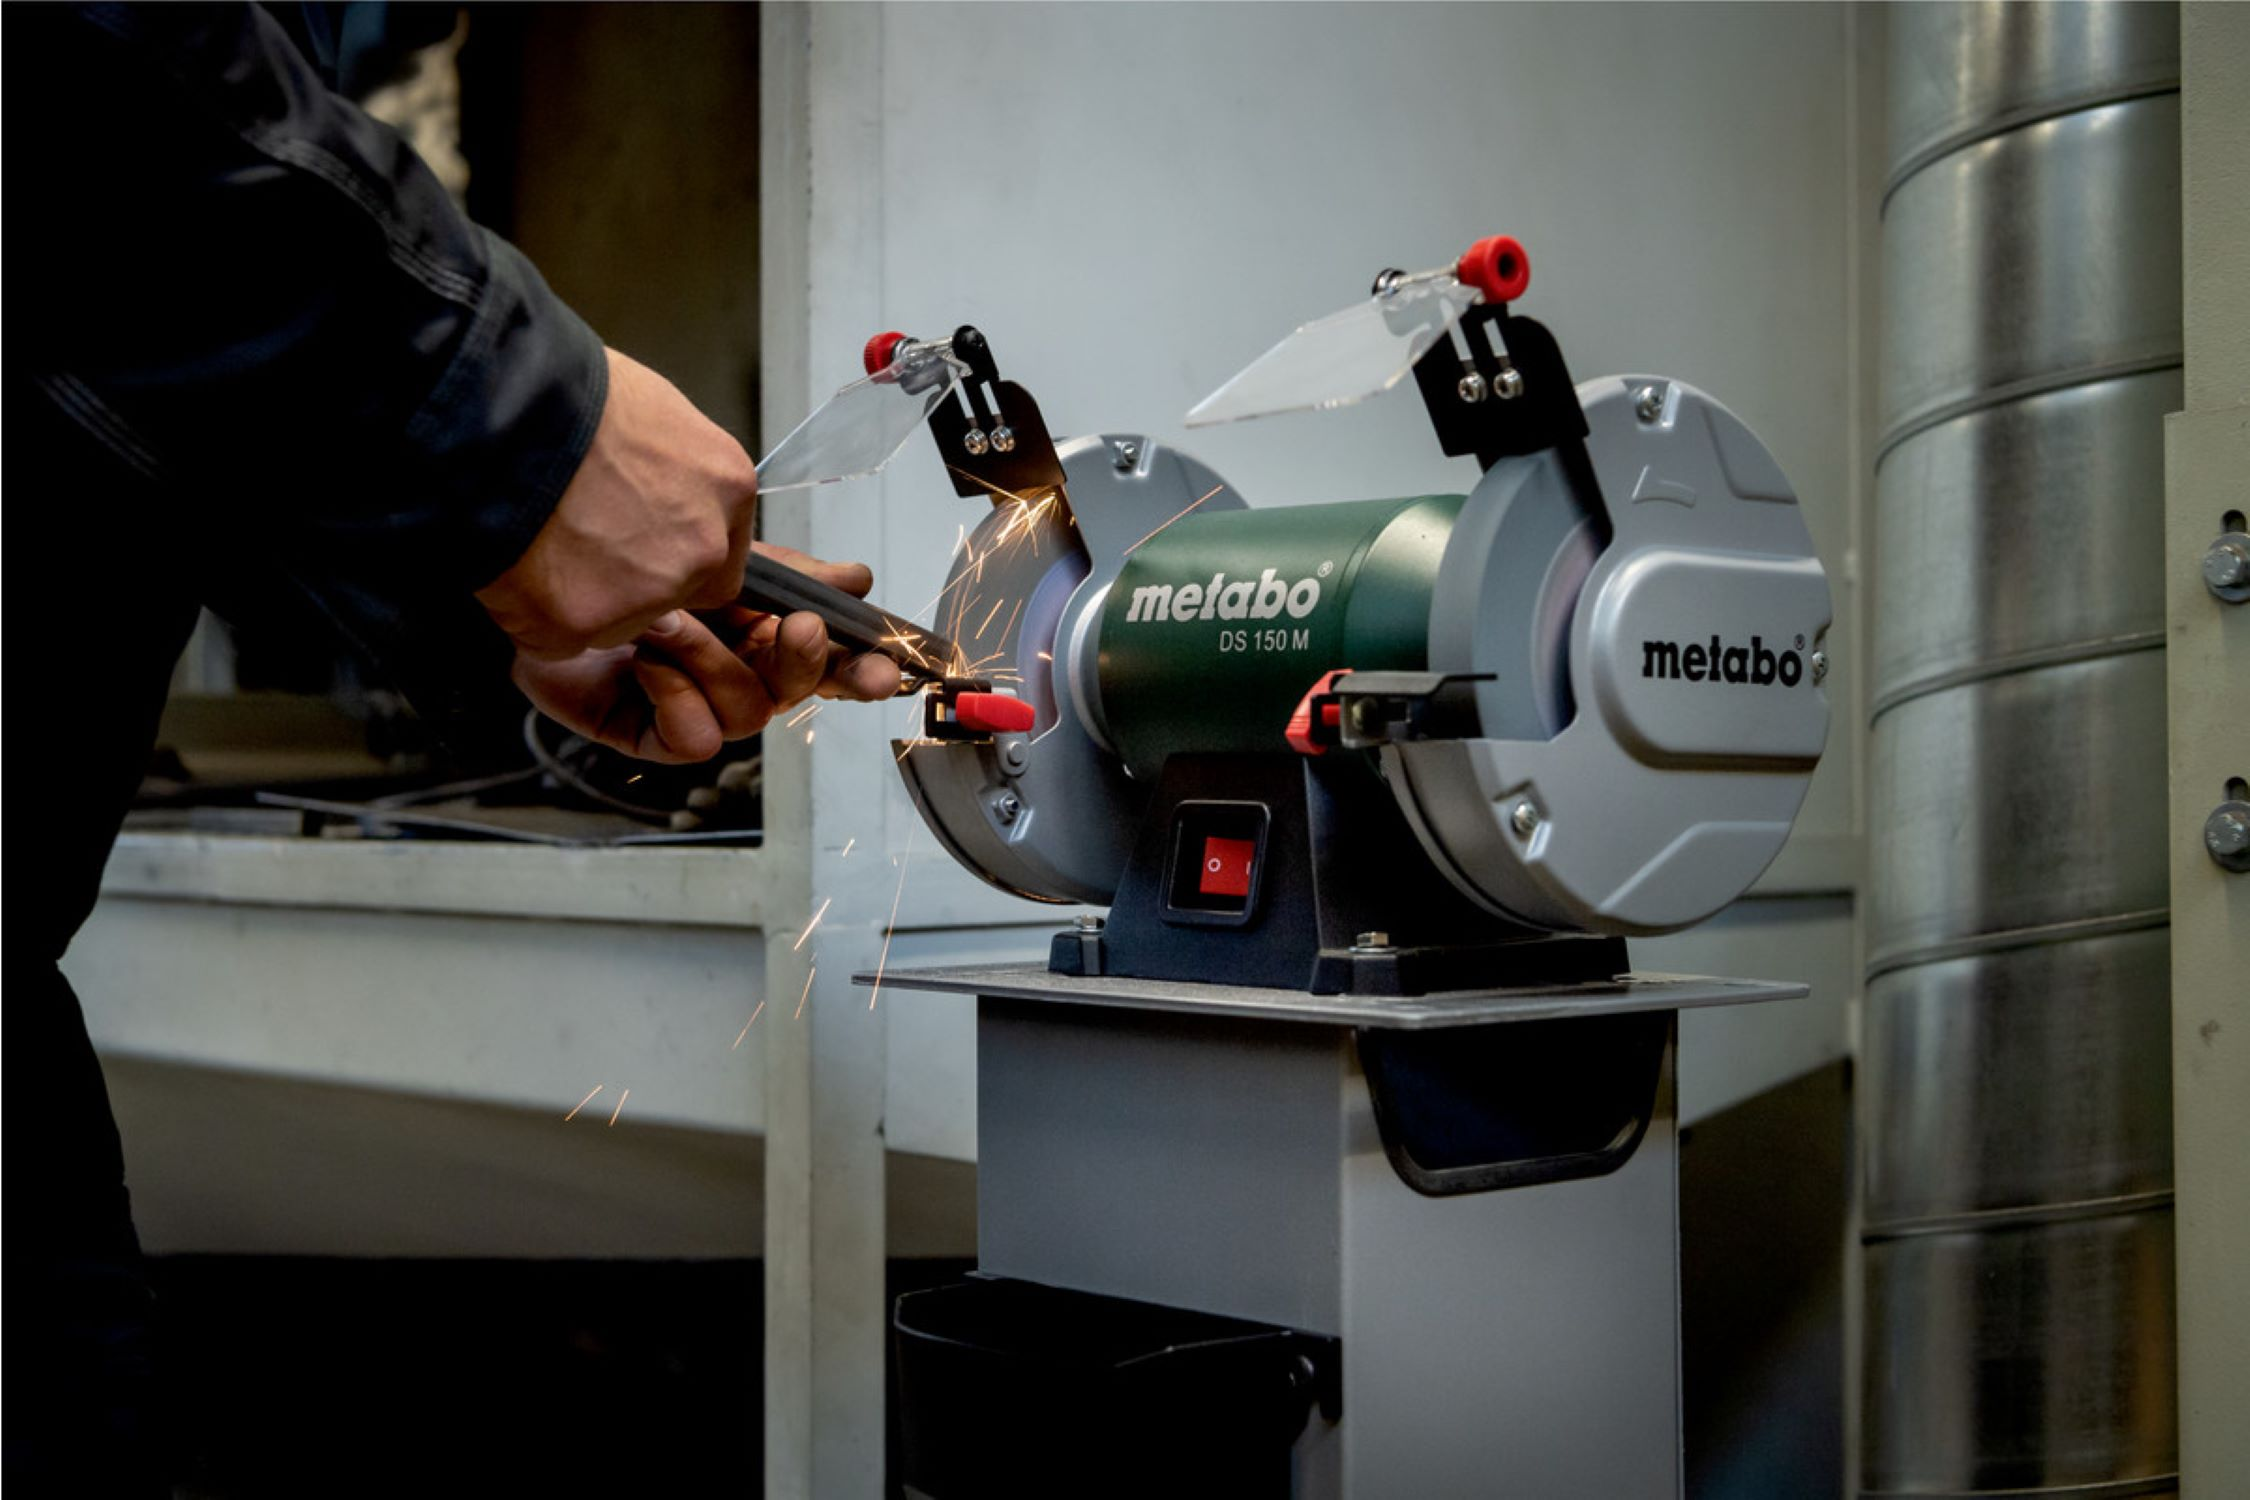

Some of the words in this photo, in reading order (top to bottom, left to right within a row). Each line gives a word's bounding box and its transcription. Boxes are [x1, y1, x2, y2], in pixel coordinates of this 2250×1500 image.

[1126, 568, 1321, 623] metabo
[1219, 631, 1248, 652] DS
[1254, 630, 1287, 651] 150
[1292, 629, 1310, 650] M
[1642, 635, 1802, 688] metabo
